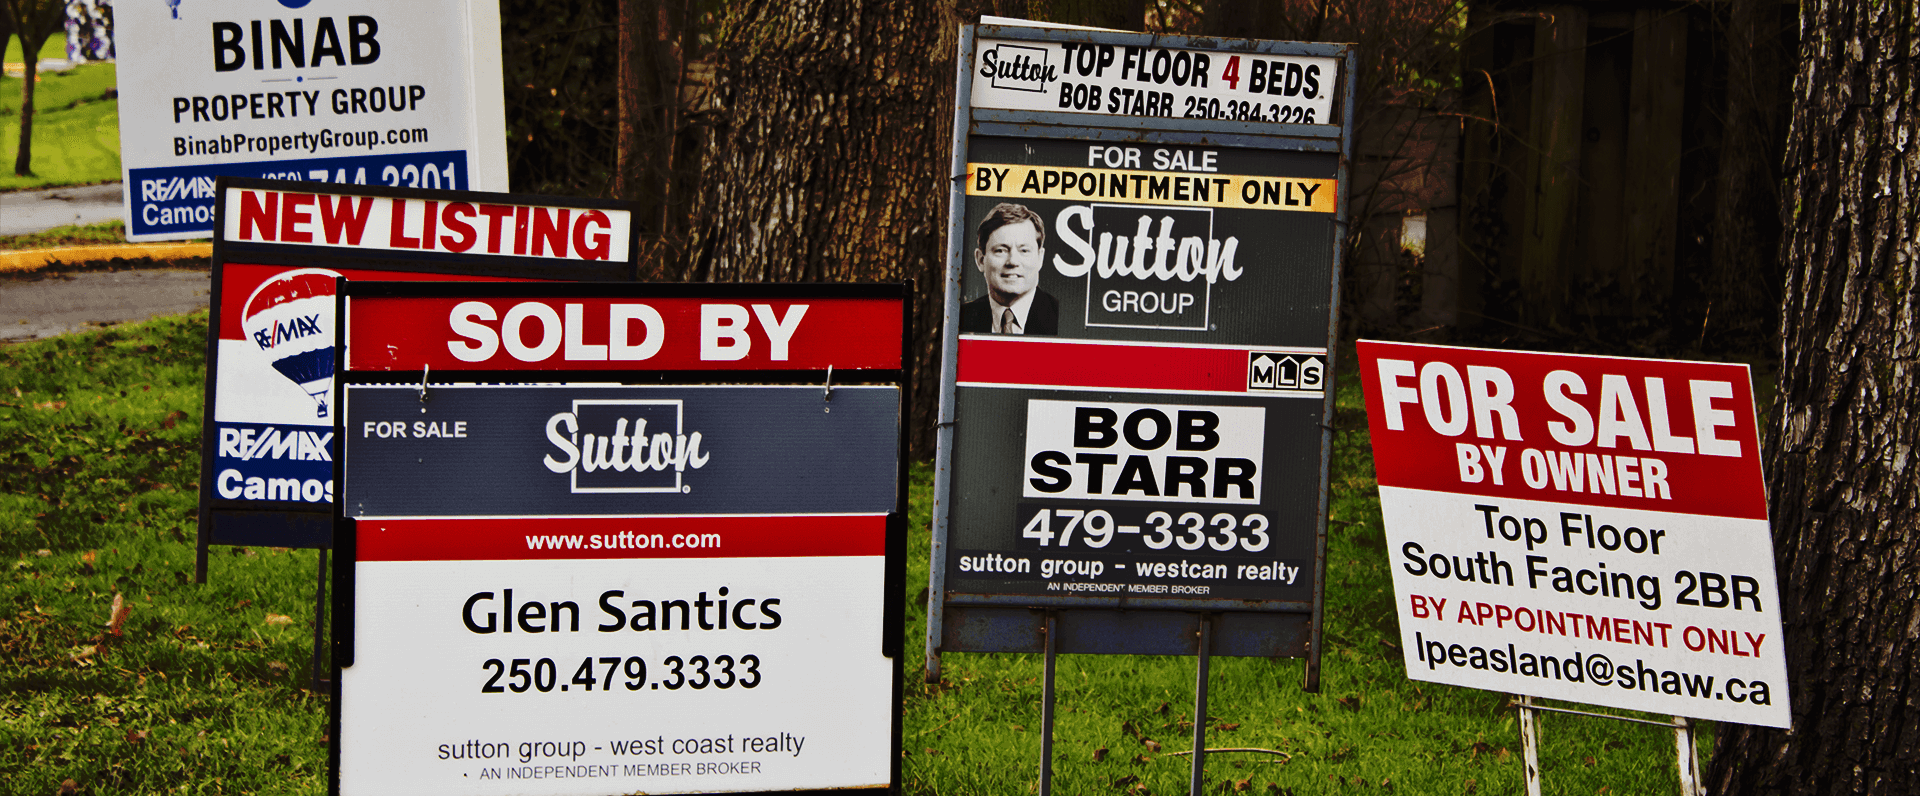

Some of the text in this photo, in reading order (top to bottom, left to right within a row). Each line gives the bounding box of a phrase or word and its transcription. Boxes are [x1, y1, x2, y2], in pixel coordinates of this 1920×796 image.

[212, 15, 382, 73] BINAB
[980, 48, 1057, 83] Sutton
[1062, 42, 1114, 77] TOP
[1122, 47, 1210, 88] FLOOR
[1222, 56, 1239, 89] 4
[173, 85, 426, 123] PROPERTY GROUP
[1059, 82, 1316, 124] BOB STARR 250-384-3226
[173, 124, 428, 156] BinabPropertyGroup.com
[1088, 146, 1218, 172] FOR SALE
[142, 176, 216, 202] RE/MAX
[976, 168, 1321, 206] BY APPOINTMENT ONLY
[239, 190, 612, 261] NEW LISTING
[1052, 205, 1243, 284] Sutton
[1102, 290, 1194, 314] GROUP
[254, 314, 322, 350] RE/MAX
[448, 302, 810, 362] SOLD BY
[1252, 363, 1321, 386] MLS
[1376, 358, 1742, 457] FOR SALE
[219, 427, 334, 461] RE/MAX
[364, 421, 467, 438] FOR SALE
[544, 411, 710, 473] Sutton
[1074, 407, 1220, 450] BOB
[1030, 451, 1256, 500] STARR
[1456, 443, 1672, 500] BY OWNER
[526, 531, 721, 551] www.sutton.com
[1023, 509, 1270, 552] 479-3333
[1475, 504, 1665, 554] Top Floor
[959, 553, 1030, 573] sutton
[1041, 558, 1104, 579] group
[1136, 560, 1227, 579] westcan
[1238, 562, 1299, 584] realty
[1063, 583, 1125, 592] INDEPENDENT
[1128, 584, 1168, 593] MEMBER
[1171, 586, 1210, 594] BROKER
[1402, 542, 1763, 611] South Facing 2BR
[462, 587, 782, 634] Glen Santics
[1410, 594, 1766, 658] BY APPOINTMENT ONLY
[482, 655, 762, 694] 250.479.3333
[1416, 632, 1770, 706] lpeasland@shaw.ca
[438, 740, 510, 760] sutton
[518, 739, 586, 763] group
[610, 736, 664, 756] west
[672, 734, 734, 754] coast
[742, 732, 805, 757] realty
[480, 762, 761, 780] AN INDEPENDENT MEMBER BROKER
